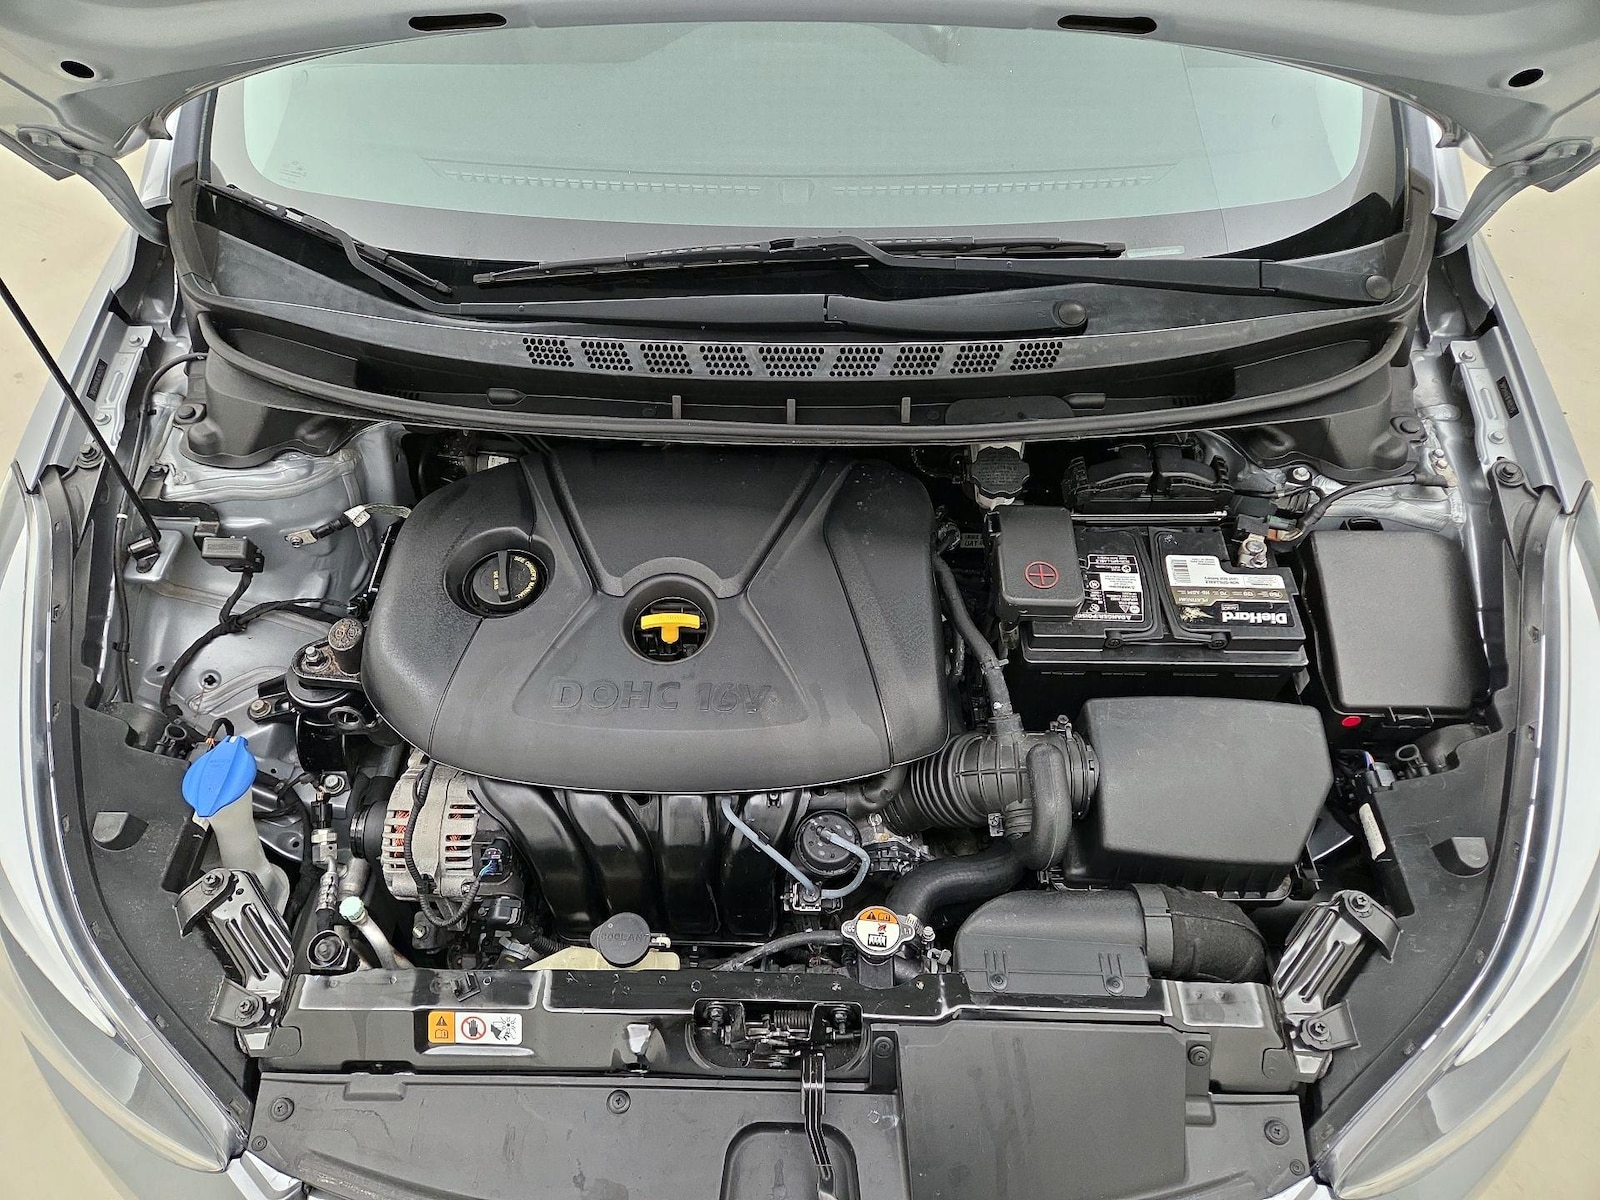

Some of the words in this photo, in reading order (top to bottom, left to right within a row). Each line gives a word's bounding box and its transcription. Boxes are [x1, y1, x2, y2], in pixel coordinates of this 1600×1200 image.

[514, 580, 535, 599] MANUAL
[1221, 611, 1288, 624] DieHard
[551, 678, 681, 710] DOHC
[696, 682, 772, 714] 16V
[601, 932, 650, 942] COOLANT
